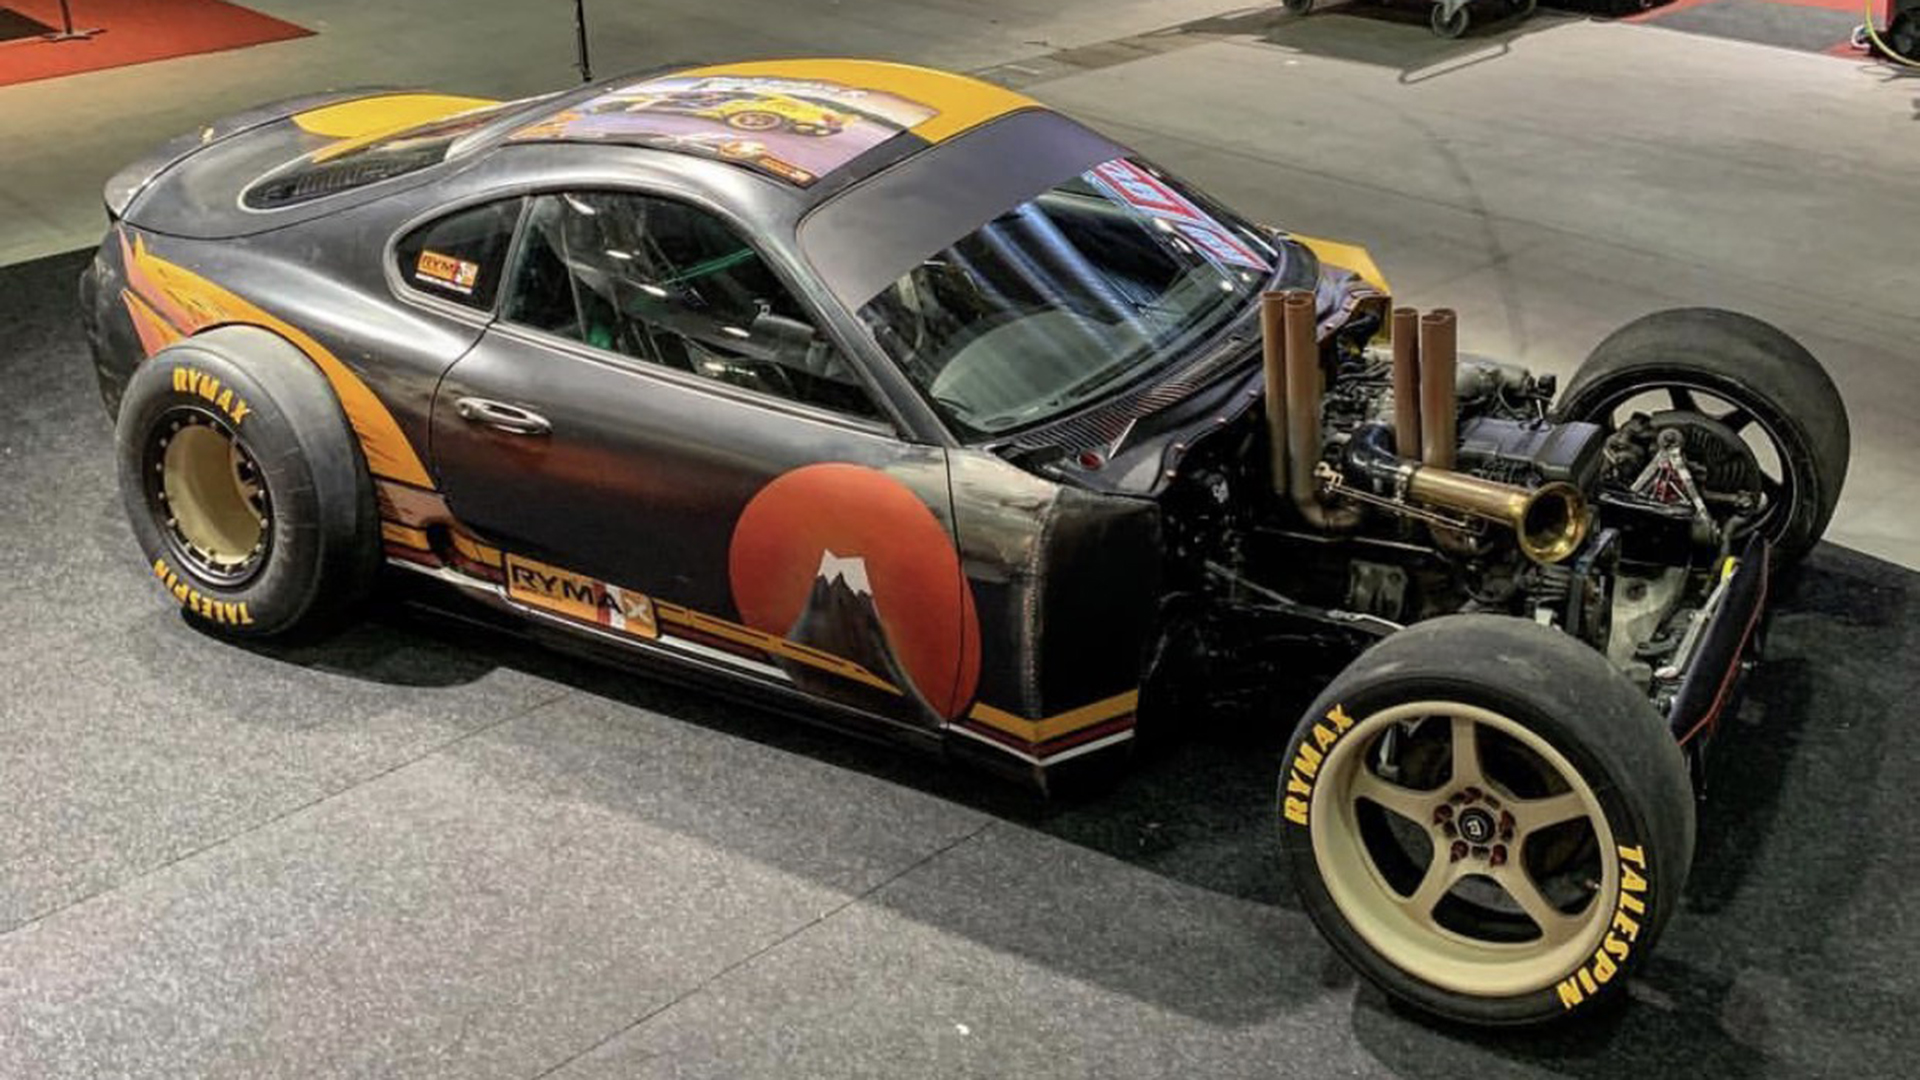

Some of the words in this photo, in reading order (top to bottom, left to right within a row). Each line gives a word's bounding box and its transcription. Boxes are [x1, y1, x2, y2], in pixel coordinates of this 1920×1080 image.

[173, 366, 252, 424] RYMAX
[154, 558, 254, 625] TALESPIN
[511, 564, 651, 624] RYMAX
[1284, 703, 1354, 825] RYMAX
[1557, 845, 1646, 1010] TALESPIN
